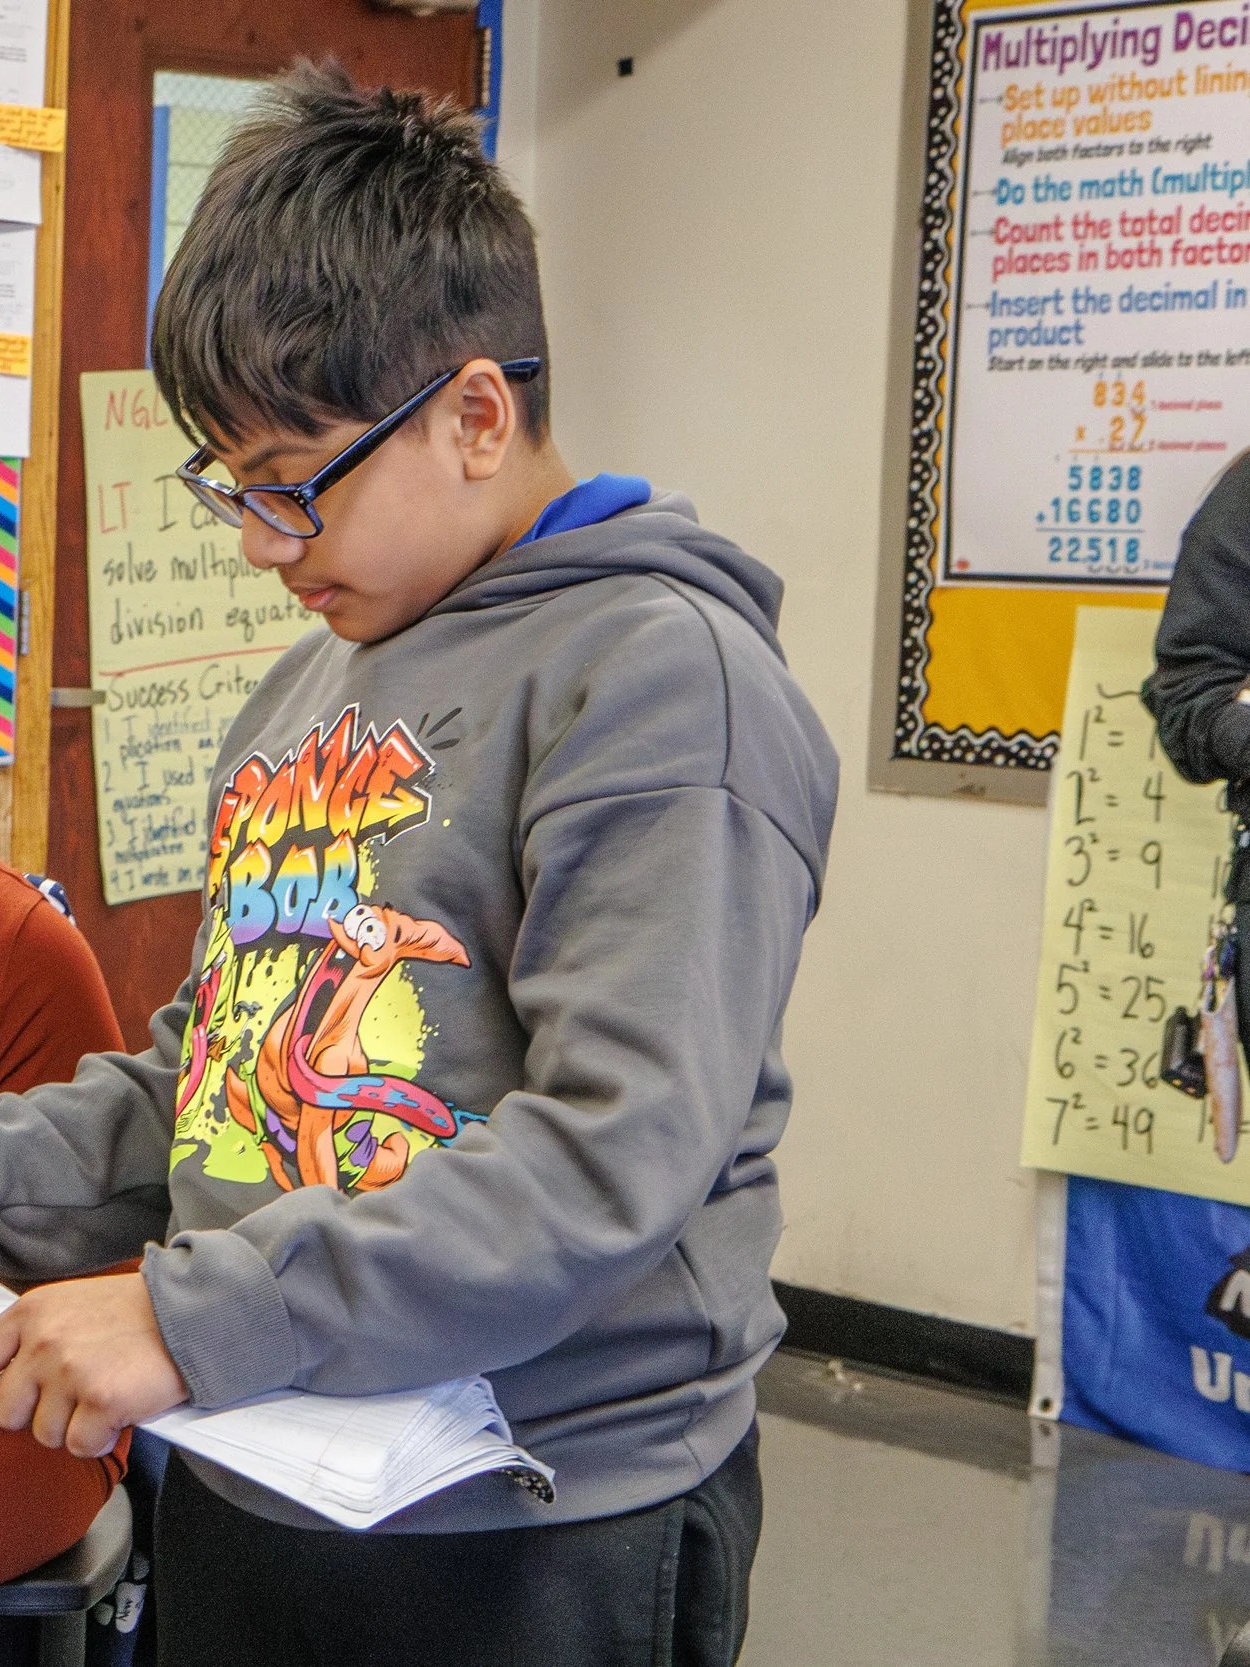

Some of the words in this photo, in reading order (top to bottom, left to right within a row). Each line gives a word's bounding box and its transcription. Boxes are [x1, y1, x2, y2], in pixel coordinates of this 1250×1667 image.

[981, 17, 1161, 76] Multiplying
[1003, 81, 1046, 112] Set
[1051, 84, 1082, 115] up
[1087, 68, 1188, 105] without
[1193, 61, 1250, 97] linin
[1001, 115, 1066, 148] place
[1073, 106, 1153, 137] values
[996, 176, 1026, 206] Do
[1032, 170, 1072, 202] the
[1078, 166, 1145, 199] math
[994, 213, 1066, 246] Count
[1071, 210, 1112, 240] the
[1119, 205, 1183, 238] total
[991, 249, 1071, 283] places
[1077, 243, 1099, 272] in
[1104, 239, 1163, 271] both
[989, 287, 1065, 317] Insert
[1071, 285, 1112, 314] the
[1118, 278, 1218, 312] decimal
[1225, 278, 1248, 310] in
[988, 319, 1085, 355] product
[1068, 464, 1142, 492] 5838
[96, 481, 133, 533] LT
[152, 474, 179, 532] I
[102, 541, 158, 587] solve
[110, 597, 204, 645] division
[107, 677, 190, 712] Success
[198, 663, 259, 700] Crite
[1141, 770, 1167, 824] 4
[1140, 840, 1163, 890] 9
[225, 832, 362, 947] BOB
[1129, 911, 1156, 960] 16
[1120, 974, 1168, 1024] 25
[1115, 1047, 1160, 1090] 36
[1111, 1103, 1155, 1155] 49
